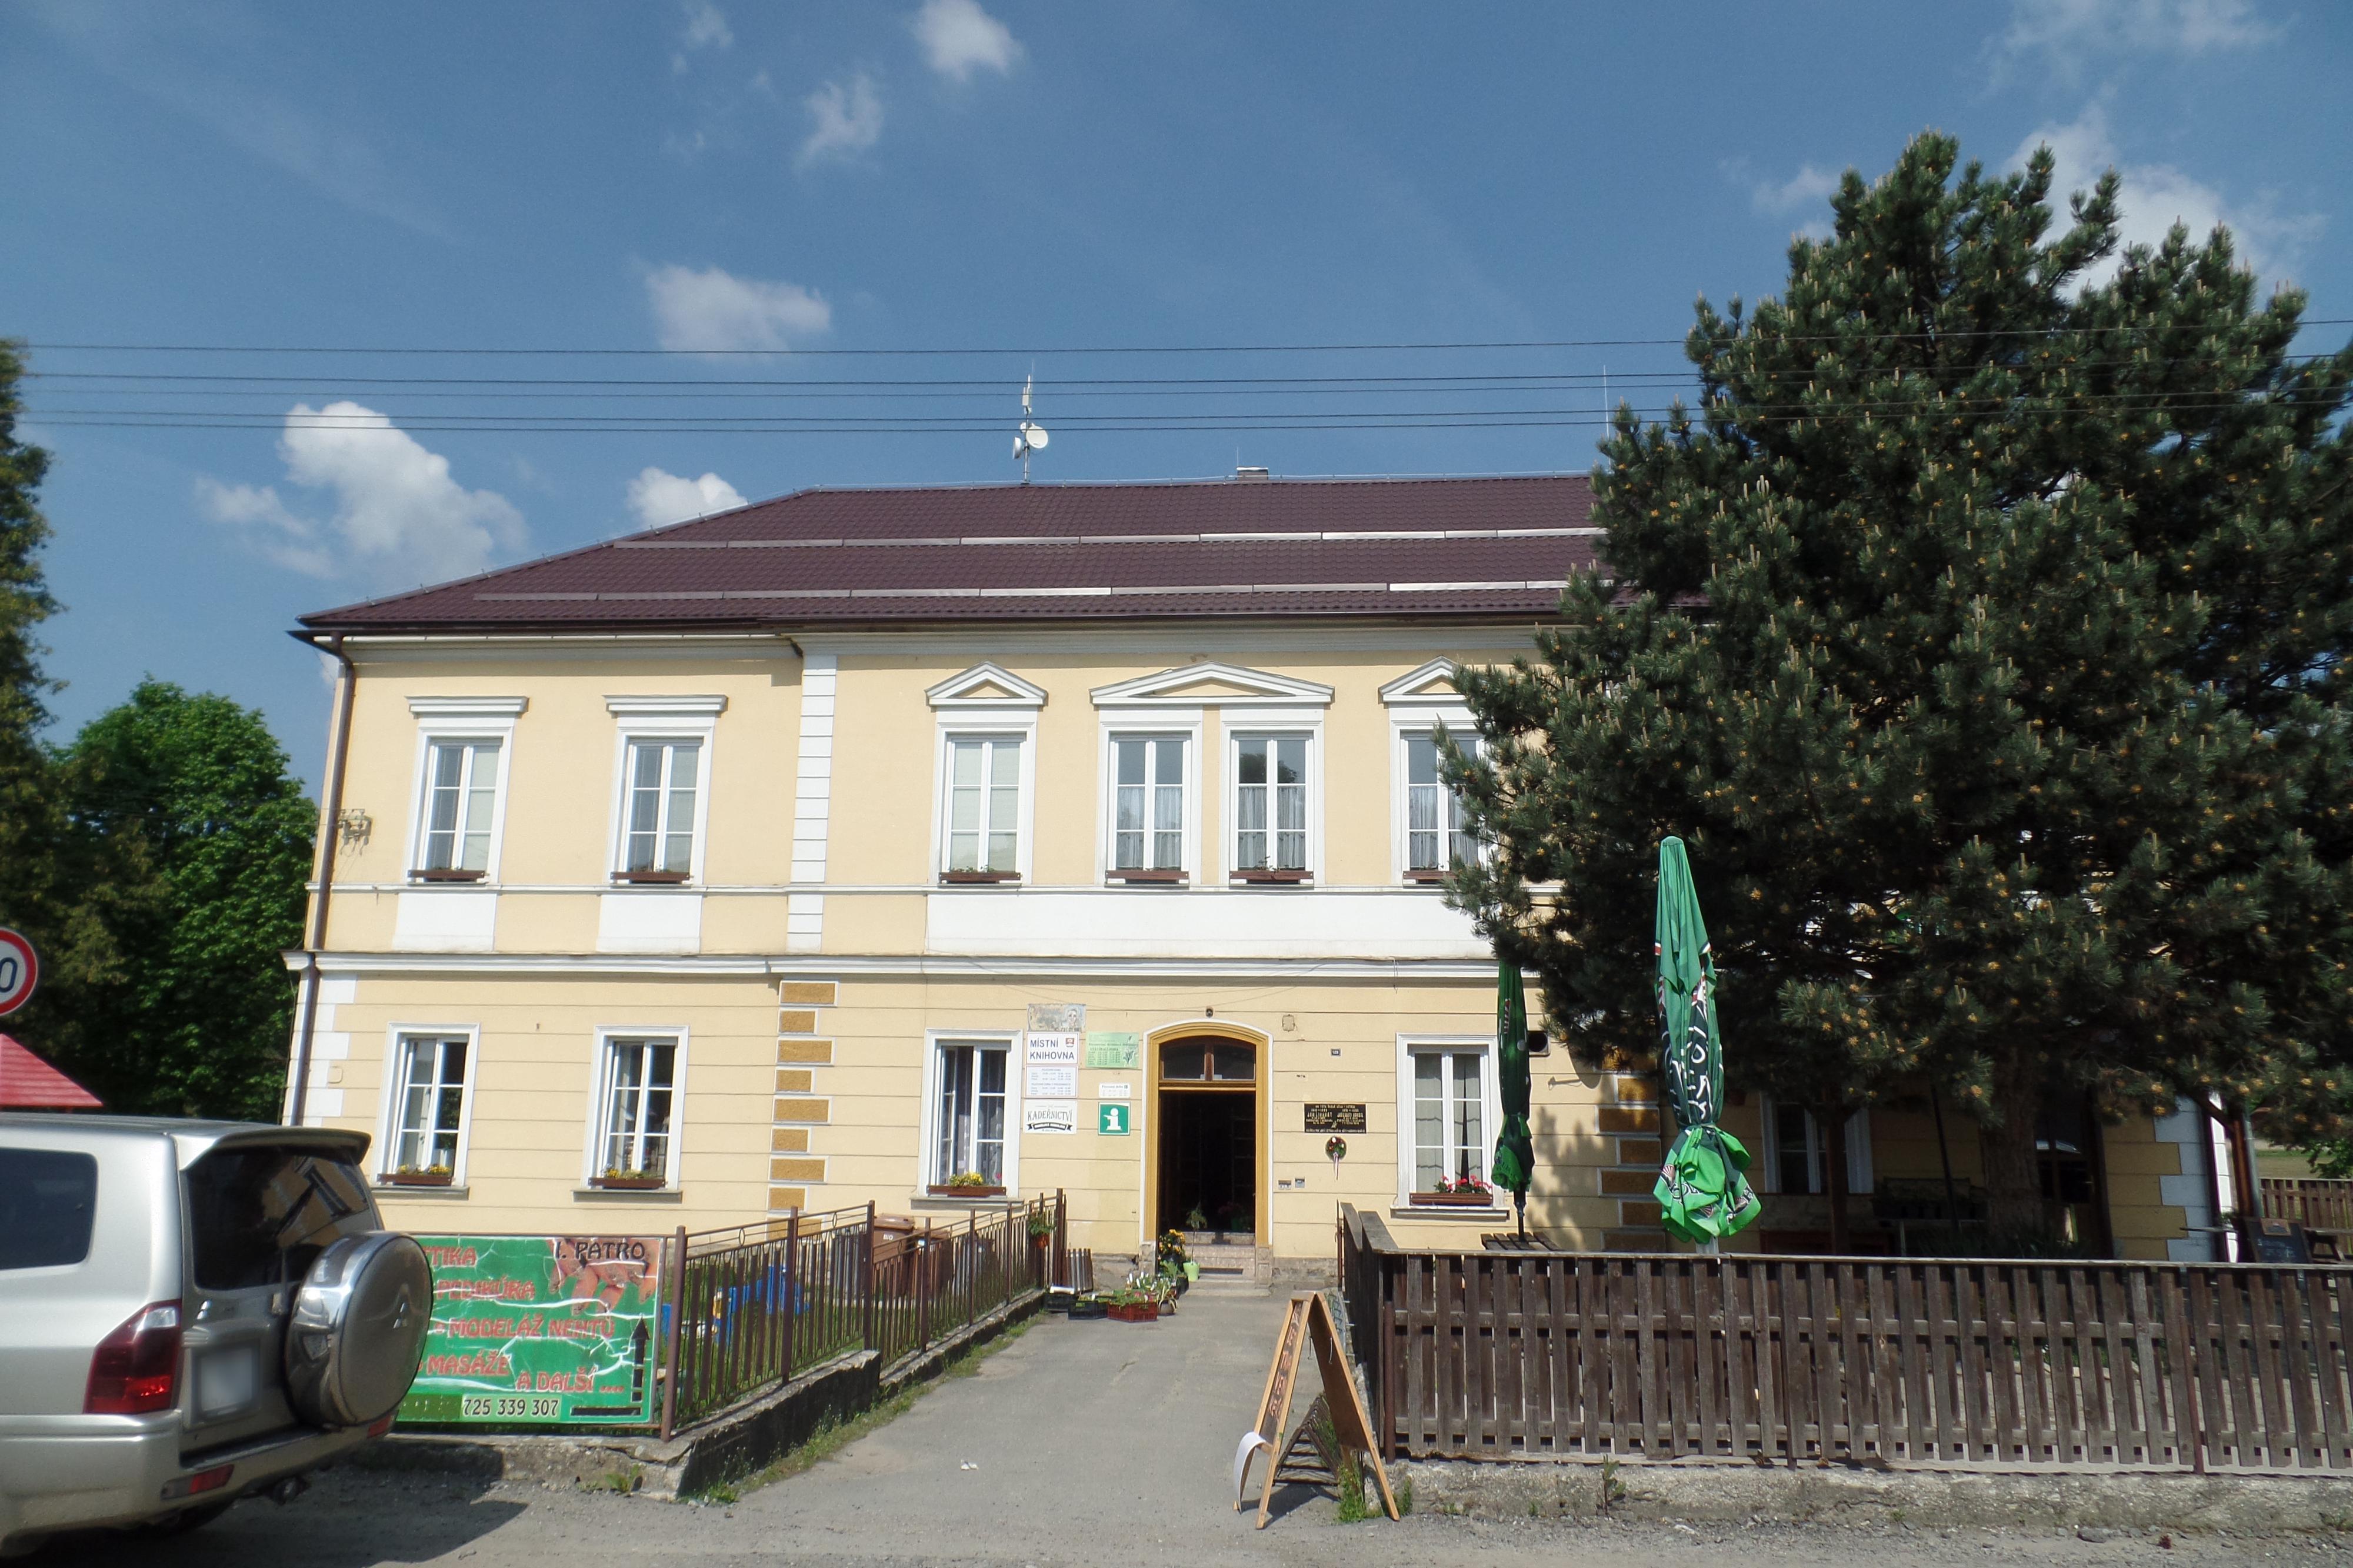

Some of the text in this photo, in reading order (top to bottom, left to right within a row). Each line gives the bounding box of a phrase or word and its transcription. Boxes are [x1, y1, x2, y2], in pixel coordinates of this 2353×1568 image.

[1030, 1037, 1058, 1047] MÍSTNÍ
[1028, 1109, 1072, 1122] KADEŘNICTVÍ
[575, 1241, 645, 1260] PATRO
[436, 1274, 535, 1300] PEDIKÚRA
[448, 1313, 544, 1338] MODELÁŽ
[426, 1349, 509, 1376] MASÁŽE
[515, 1370, 531, 1392] A
[536, 1363, 597, 1393] DALŠÍ
[464, 1399, 559, 1416] 725 339 307
